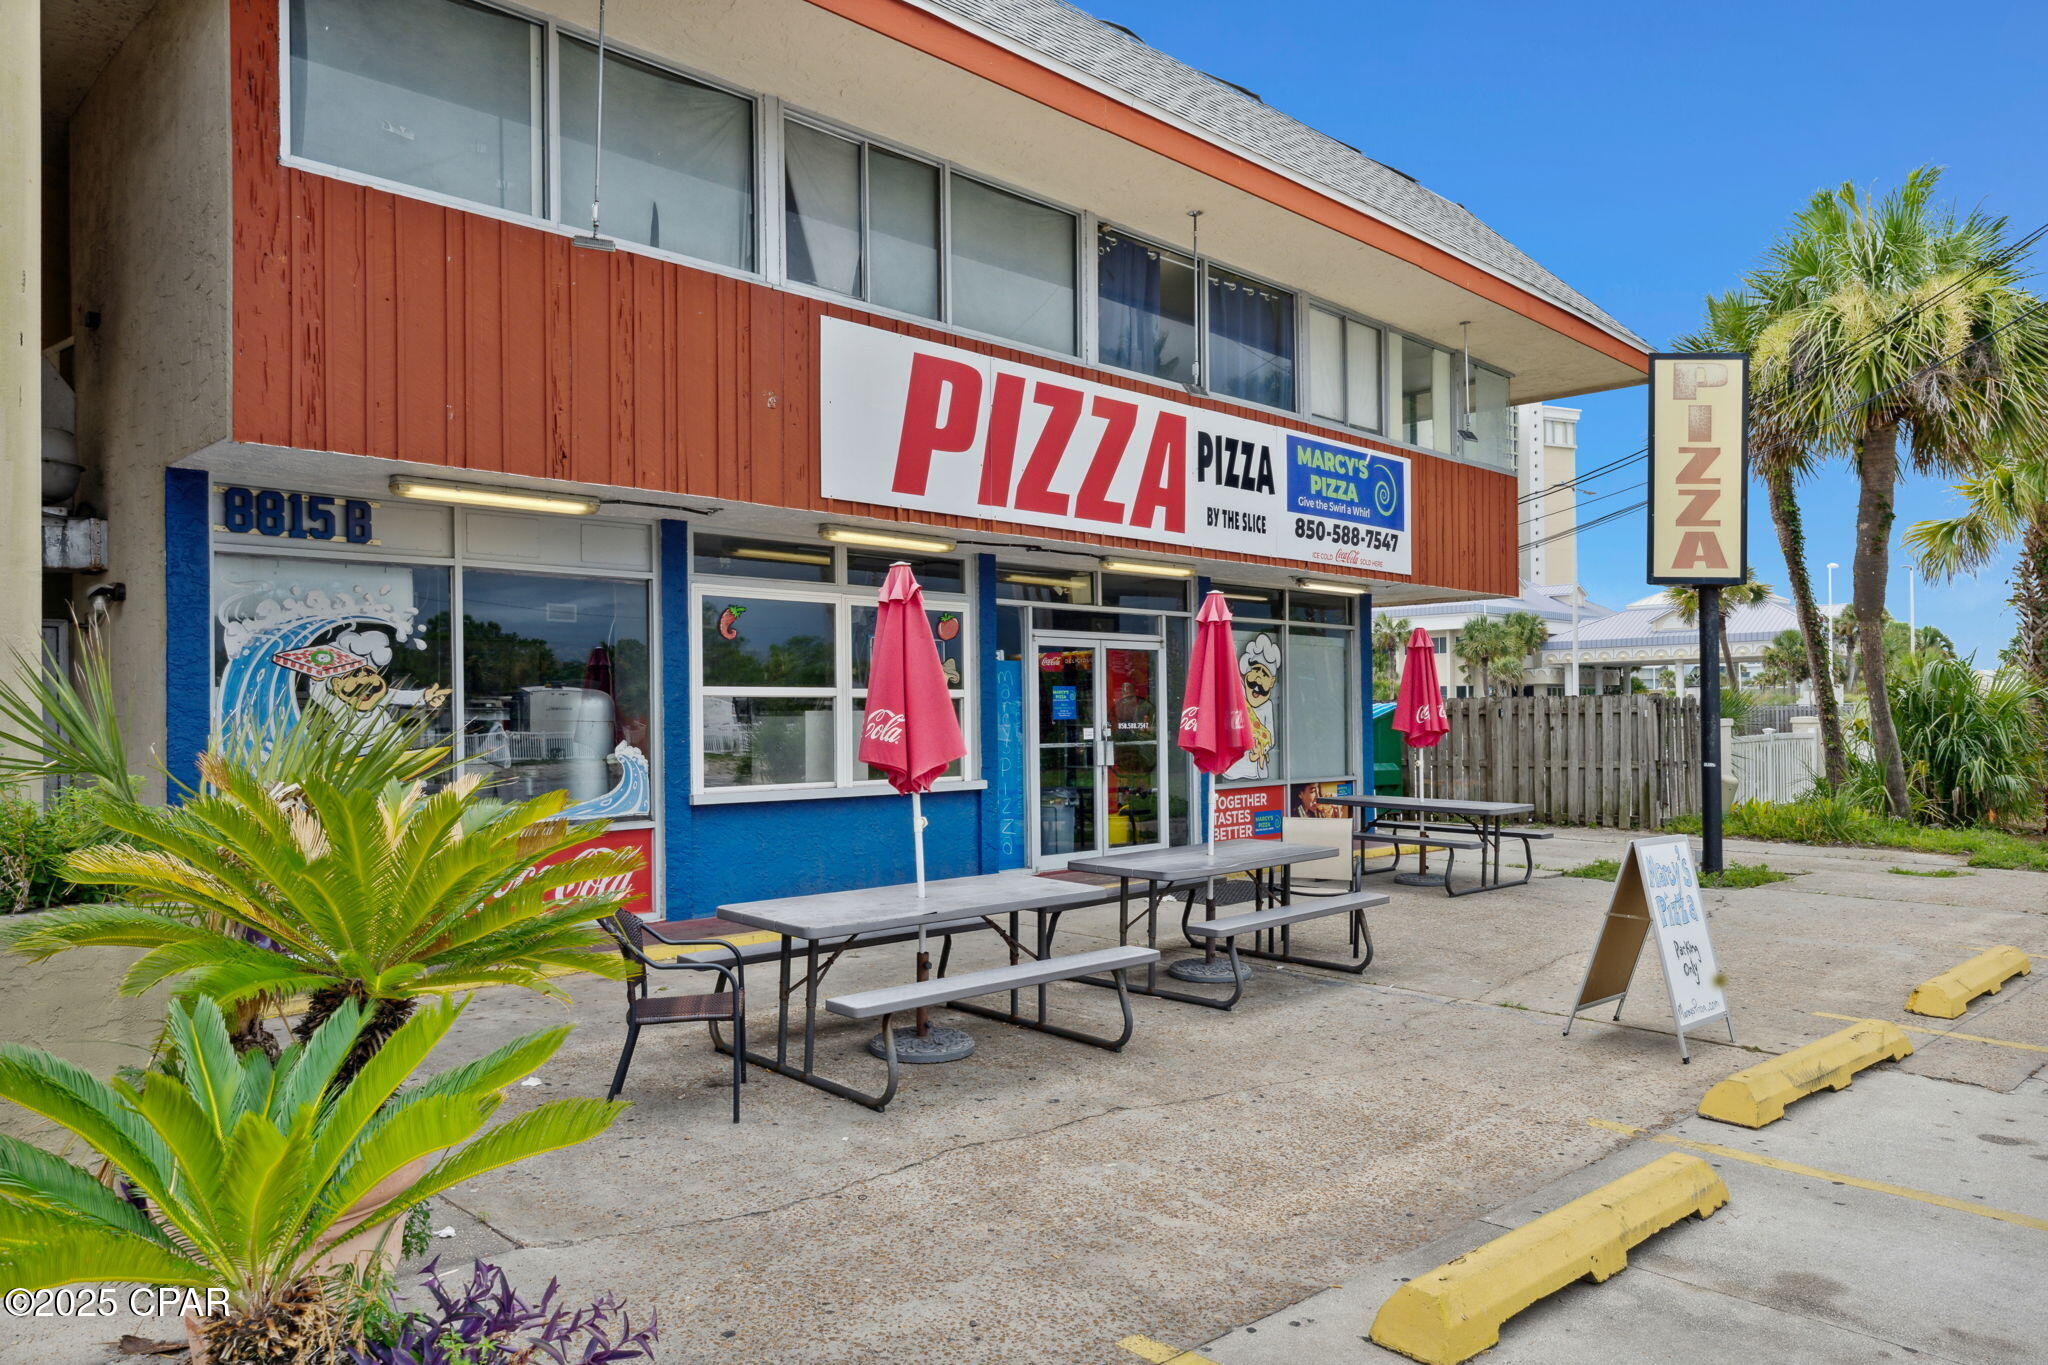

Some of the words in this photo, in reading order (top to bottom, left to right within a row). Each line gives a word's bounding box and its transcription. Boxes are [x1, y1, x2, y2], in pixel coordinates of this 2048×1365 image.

[891, 352, 1187, 535] PIZZA
[1197, 430, 1276, 495] PIZZA
[1297, 445, 1369, 479] MARCY'S
[1671, 363, 1729, 569] PIZZA
[1310, 475, 1359, 503] PIZZA
[225, 487, 336, 541] 8815
[347, 499, 373, 544] B
[1207, 506, 1219, 527] BY
[1222, 509, 1240, 530] THE
[1242, 512, 1266, 534] SLICE
[1298, 496, 1315, 508] Give
[1316, 499, 1328, 511] the
[1329, 502, 1346, 514] Swirl
[1347, 507, 1352, 515] a
[1352, 506, 1371, 518] Whirl
[1295, 517, 1399, 553] 850-588-7547
[1320, 553, 1333, 561] COLD
[1360, 558, 1372, 566] SOLD
[1372, 560, 1384, 568] HERE
[1655, 893, 1699, 928] Pizza
